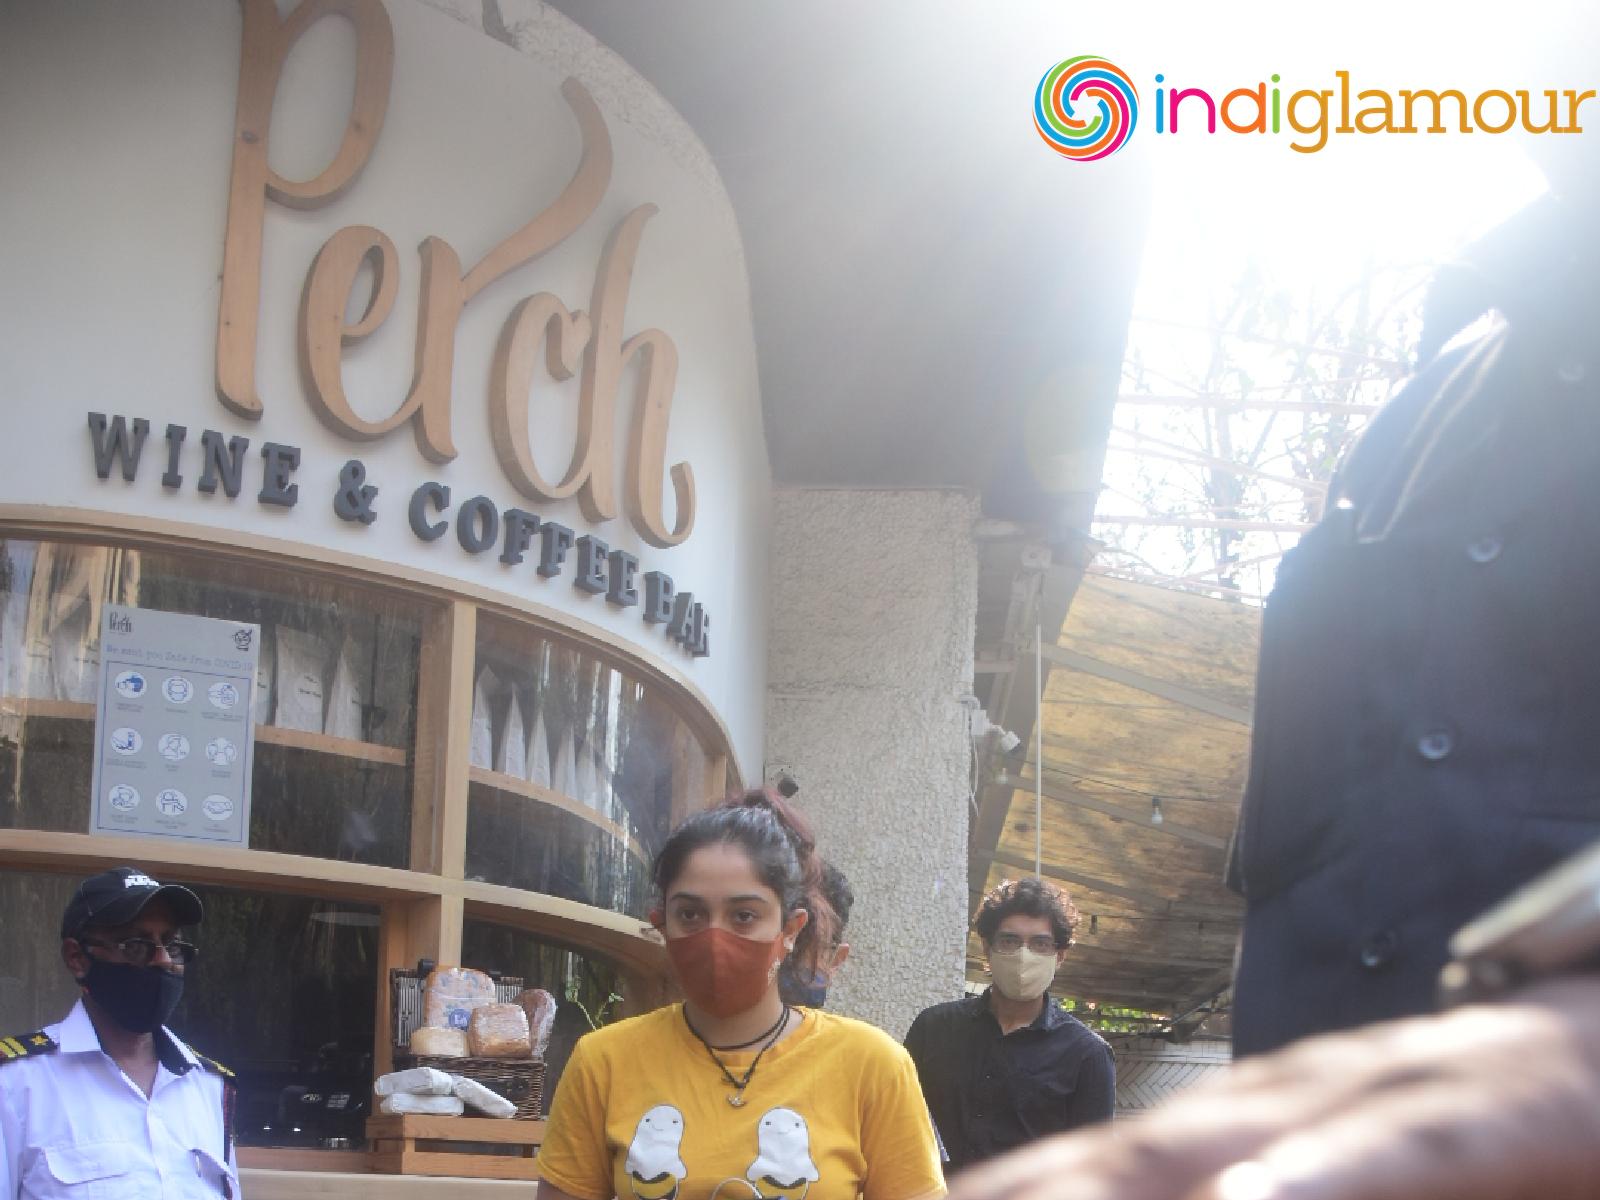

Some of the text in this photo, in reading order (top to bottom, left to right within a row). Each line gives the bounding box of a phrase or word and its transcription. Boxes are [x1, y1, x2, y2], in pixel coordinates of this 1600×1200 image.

[214, 0, 695, 549] Perch
[87, 411, 711, 658] WINE & COFFEE BAR
